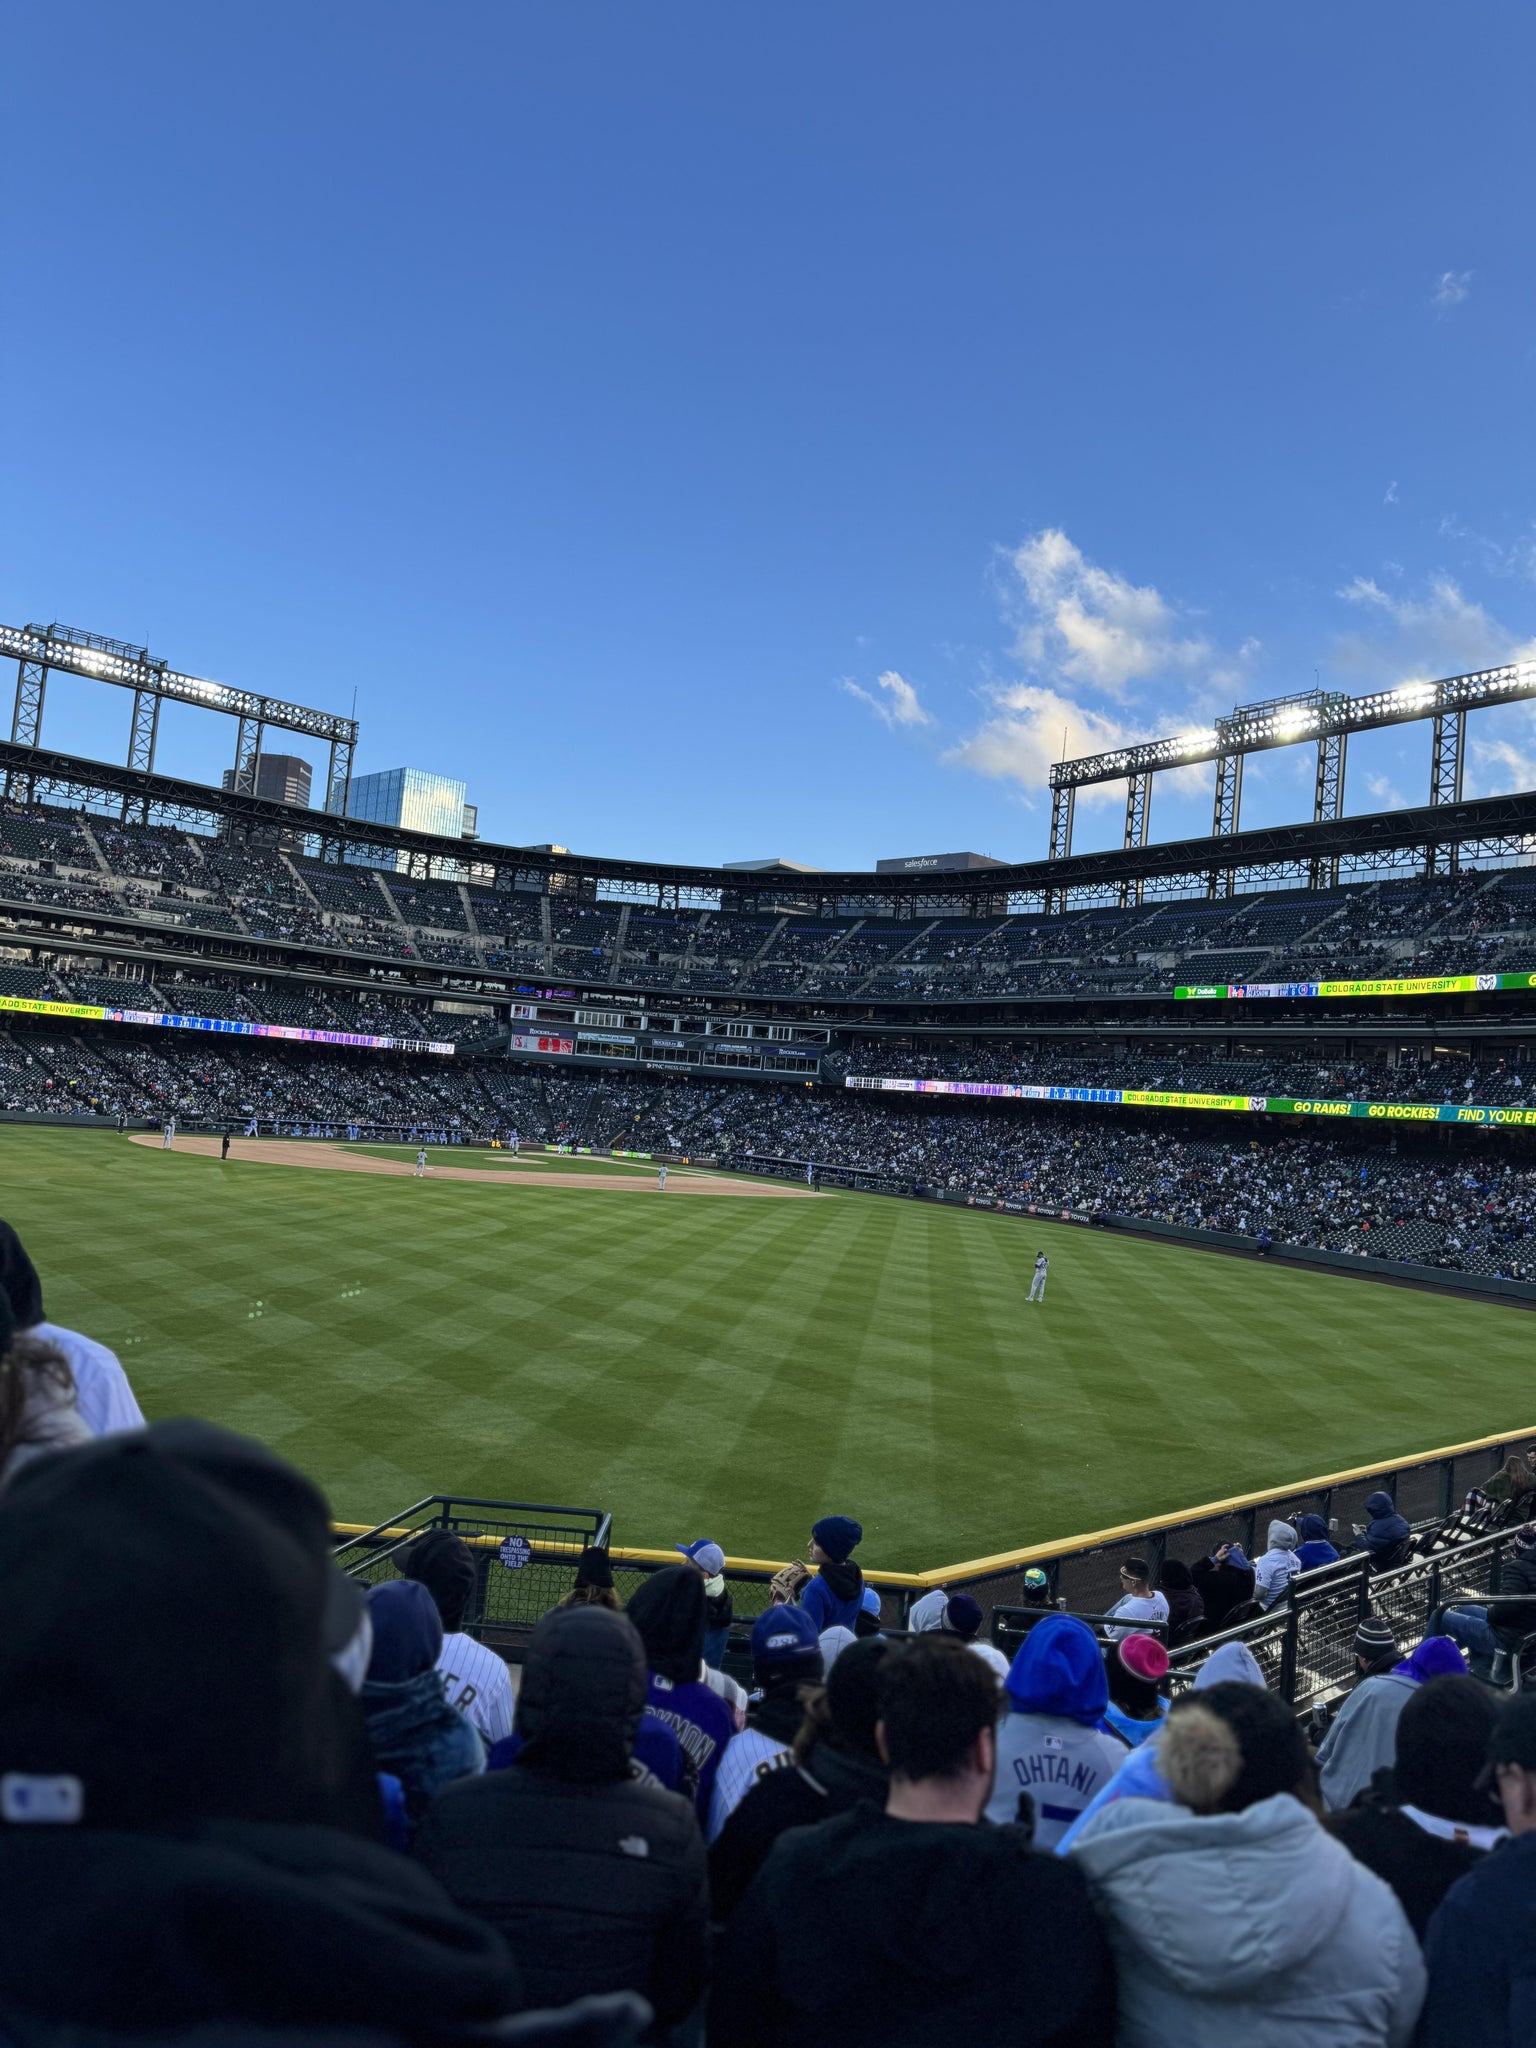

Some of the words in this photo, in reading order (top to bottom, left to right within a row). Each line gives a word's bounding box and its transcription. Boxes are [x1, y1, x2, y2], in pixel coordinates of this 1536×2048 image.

[904, 858, 938, 869] salesforce
[1326, 983, 1374, 993] COLORADO
[1375, 982, 1404, 992] STATE
[1406, 980, 1457, 990] UNIVERSITY
[21, 1001, 48, 1011] STATE
[50, 1005, 99, 1016] UNIVERSITY
[1127, 1094, 1164, 1103] COLORADO
[1165, 1095, 1187, 1104] STATE
[1188, 1098, 1233, 1107] UNIVERSITY
[1293, 1101, 1311, 1113] GO
[1312, 1102, 1352, 1115] RAMS!
[1368, 1104, 1386, 1117] GO
[1387, 1105, 1441, 1119] ROCKIES!
[1457, 1108, 1485, 1122] FIND
[1489, 1109, 1523, 1123] YOUR
[1005, 1202, 1022, 1210] TOYOTA
[1037, 1207, 1055, 1216] TOYOTA
[1070, 1213, 1090, 1223] TOYOTA
[509, 1537, 523, 1547] NO
[500, 1546, 531, 1555] TRESPASSING
[500, 1553, 516, 1561] ONTO
[504, 1560, 523, 1568] FIELD
[1012, 1754, 1097, 1796] OHTANI
